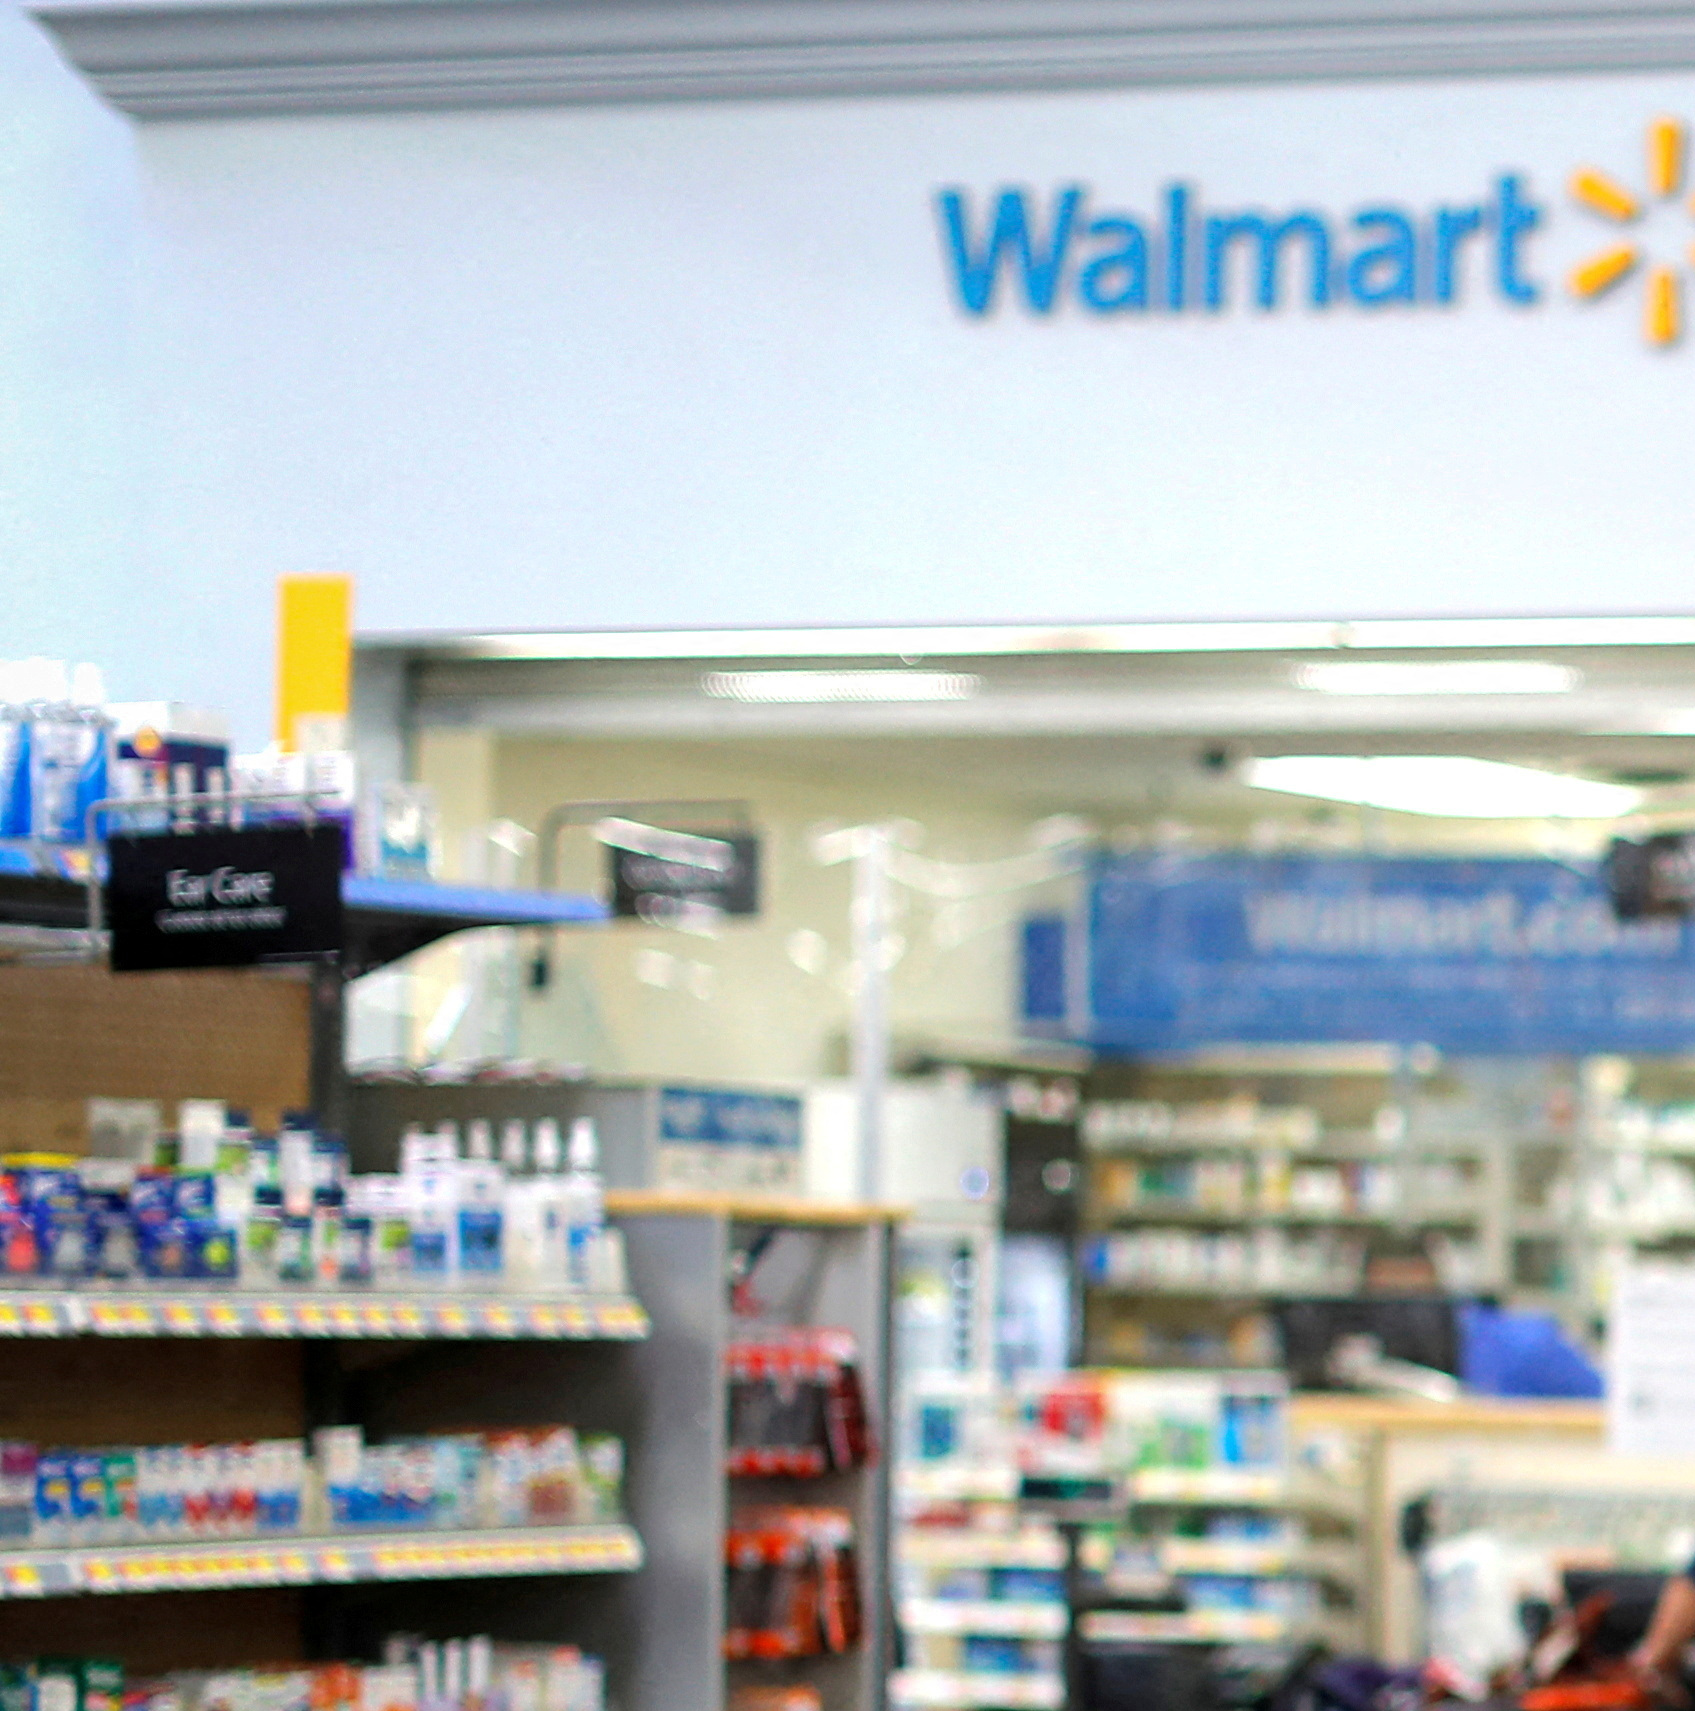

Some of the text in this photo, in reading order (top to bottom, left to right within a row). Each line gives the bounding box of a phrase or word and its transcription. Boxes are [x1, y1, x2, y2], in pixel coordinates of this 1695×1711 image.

[934, 170, 1546, 320] Walmart
[166, 866, 274, 906] Ear Care
